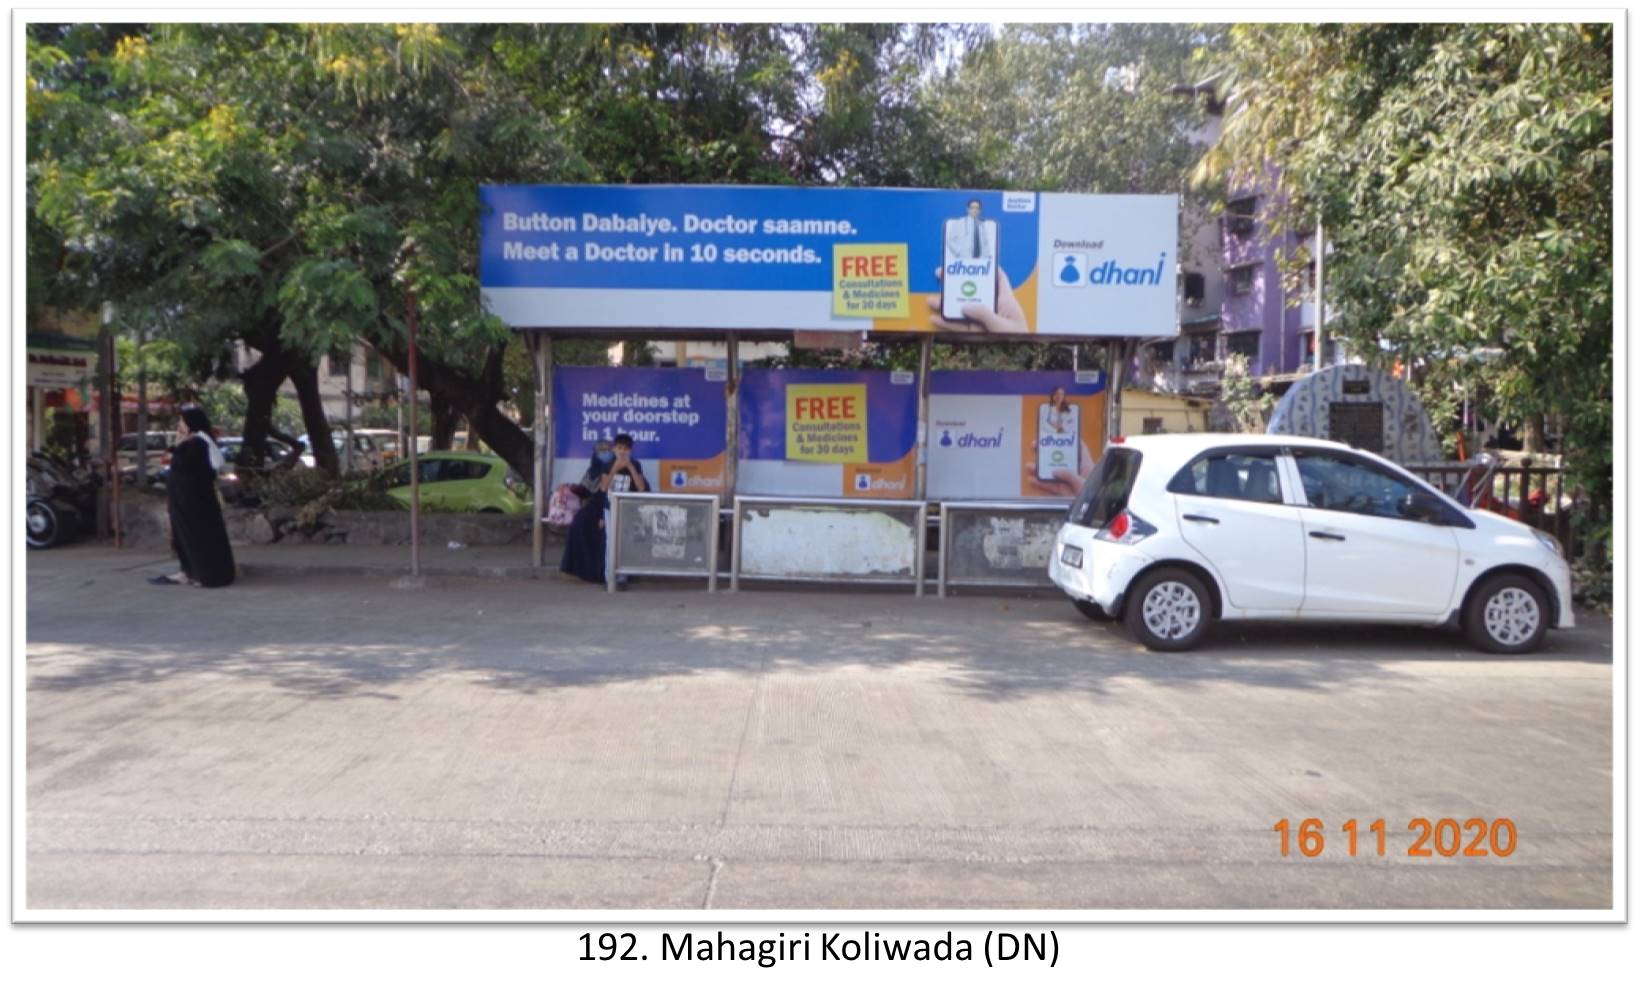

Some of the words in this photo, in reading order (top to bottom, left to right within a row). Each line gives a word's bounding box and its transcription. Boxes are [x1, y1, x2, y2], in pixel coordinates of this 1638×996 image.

[503, 213, 576, 232] Button
[583, 213, 677, 236] Dabaiye.
[684, 214, 758, 234] Doctor
[763, 218, 858, 236] saamne.
[1053, 240, 1104, 249] Download
[503, 242, 559, 260] Meet
[564, 246, 578, 261] a
[585, 242, 658, 261] Doctor
[664, 242, 683, 262] in
[691, 244, 717, 262] 10
[724, 244, 822, 264] seconds.
[842, 255, 898, 277] FREE
[947, 256, 992, 275] dhani
[1090, 251, 1167, 285] dhani
[840, 280, 902, 289] Consultations
[843, 290, 850, 300] &
[853, 289, 900, 299] Medicines
[847, 301, 859, 310] for
[876, 301, 897, 312] days
[582, 393, 668, 408] Medicines
[673, 394, 691, 408] at
[795, 396, 856, 419] FREE
[582, 410, 619, 425] your
[623, 409, 699, 426] doorstep
[582, 427, 597, 441] in
[603, 427, 613, 441] 1
[792, 422, 862, 432] Consultations
[796, 434, 804, 443] &
[807, 433, 858, 442] Medicines
[958, 427, 1004, 448] dhani
[800, 445, 813, 454] for
[816, 445, 829, 454] 30
[832, 444, 854, 456] days
